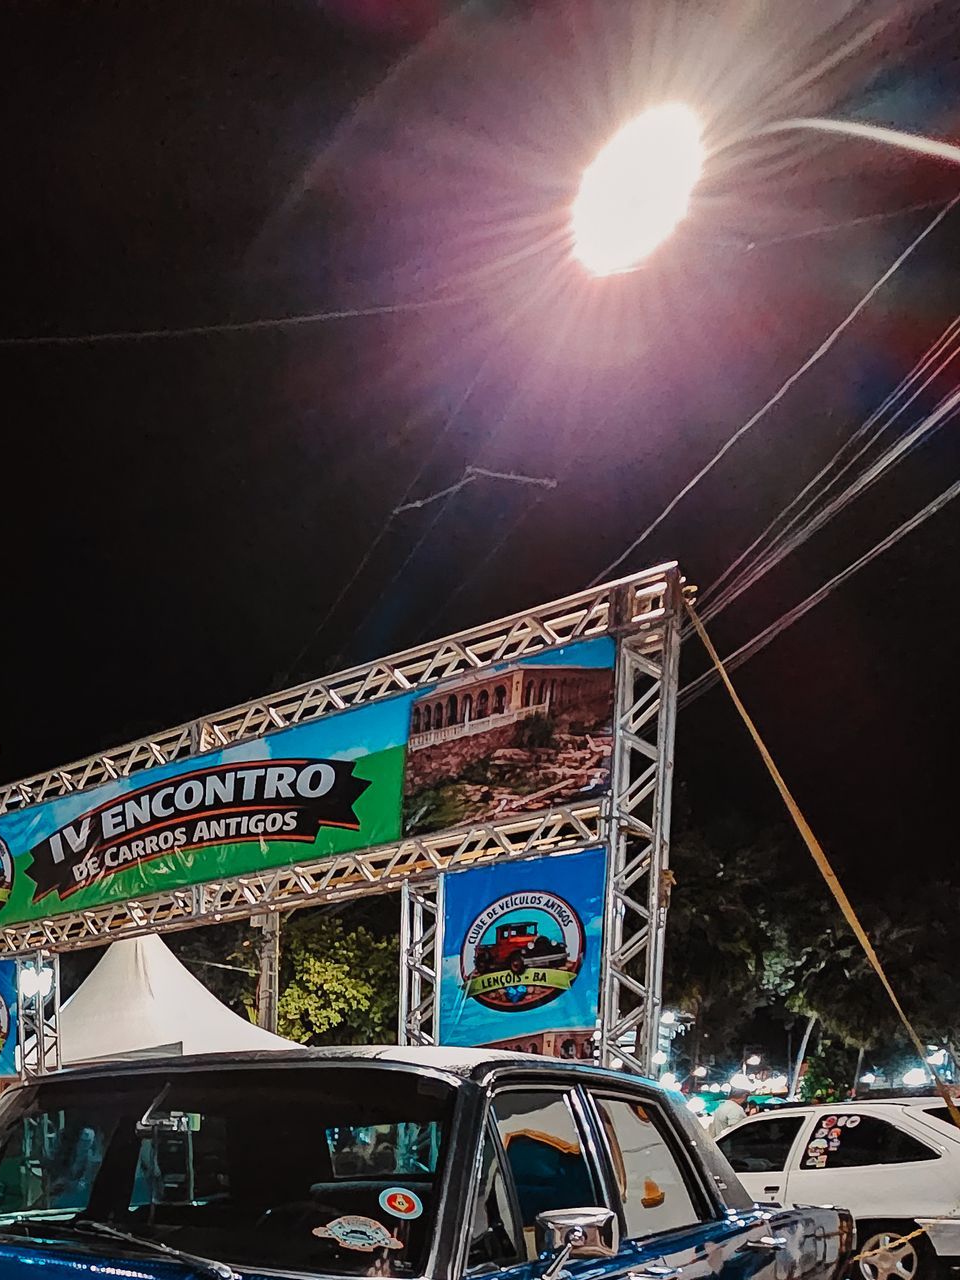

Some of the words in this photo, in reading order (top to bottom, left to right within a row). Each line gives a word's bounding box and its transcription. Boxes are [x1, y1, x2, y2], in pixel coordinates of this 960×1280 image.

[49, 817, 91, 864] IV
[101, 763, 335, 840] ENCONTRO
[72, 857, 100, 882] DE
[104, 827, 187, 868] CARROS
[193, 811, 297, 842] ANTIGOS
[468, 918, 486, 945] CLUBE
[486, 907, 499, 920] DE
[498, 895, 544, 911] VEÍCULOS
[543, 899, 574, 928] ANTIGOS
[533, 972, 547, 982] BA
